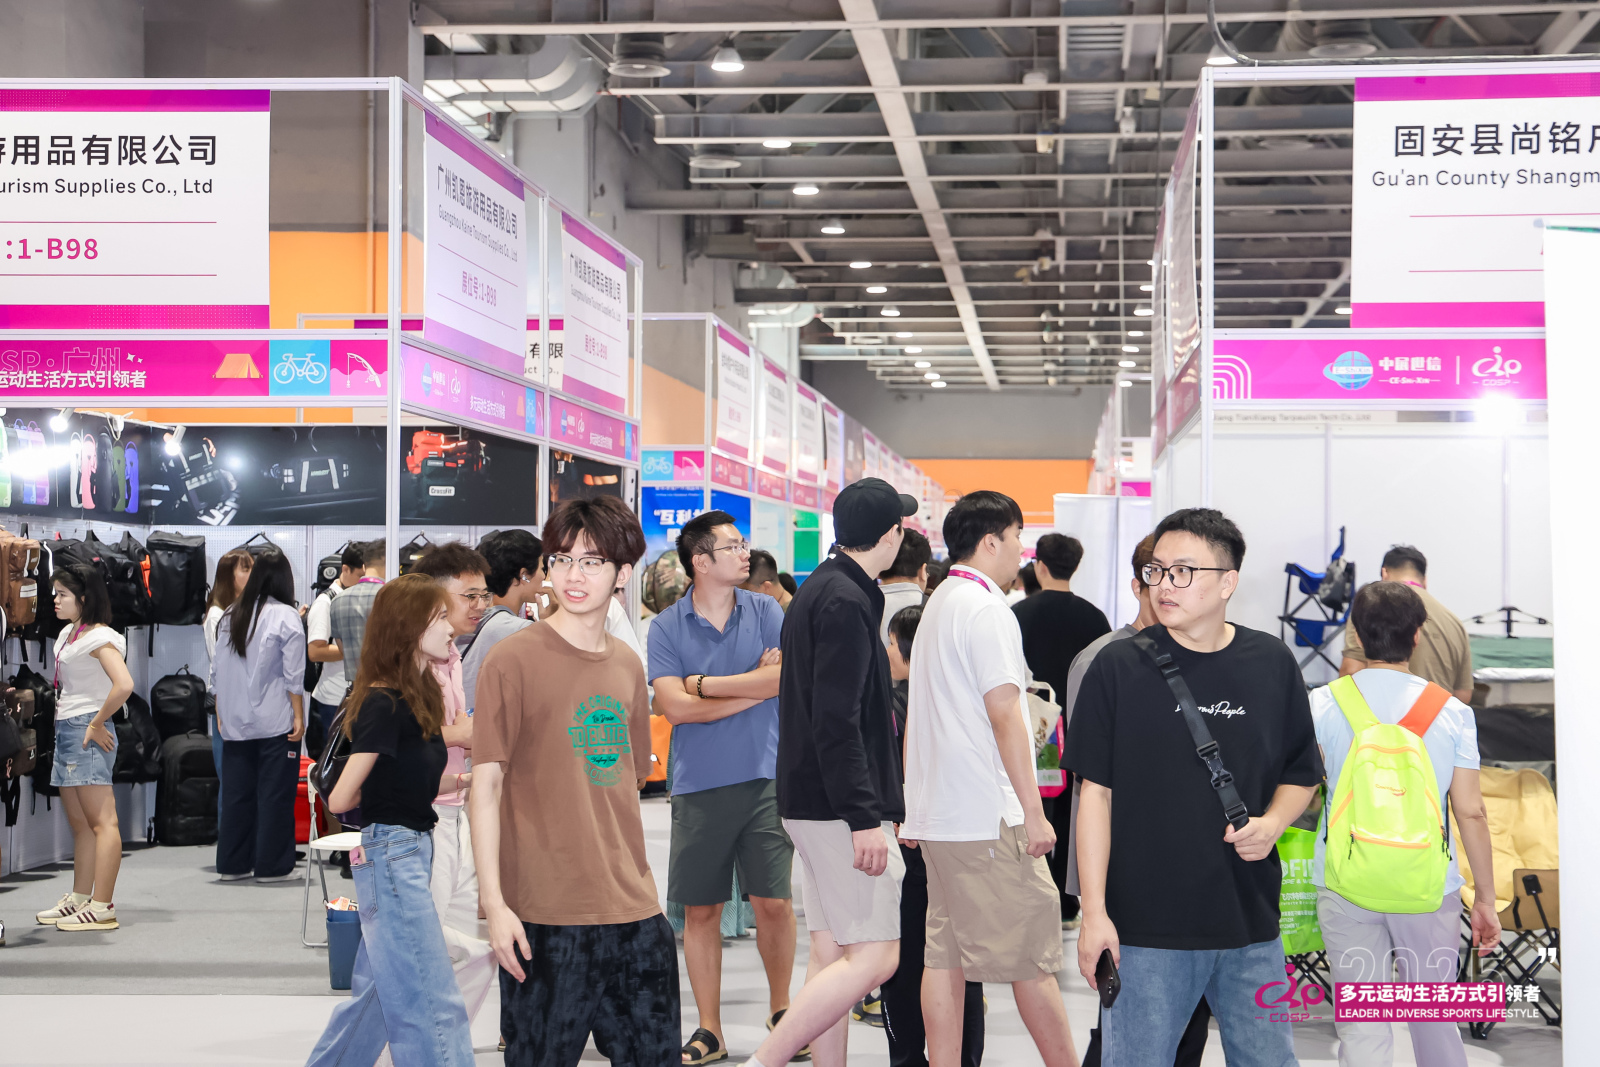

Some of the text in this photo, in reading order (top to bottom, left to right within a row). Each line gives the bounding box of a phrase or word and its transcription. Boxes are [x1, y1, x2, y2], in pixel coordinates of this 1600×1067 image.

[0, 134, 217, 166] 用品有限公司
[54, 178, 136, 198] Supplies
[142, 178, 177, 197] Co.,
[183, 178, 213, 194] Ltd
[1371, 168, 1429, 187] Gu'an
[1436, 169, 1510, 189] County
